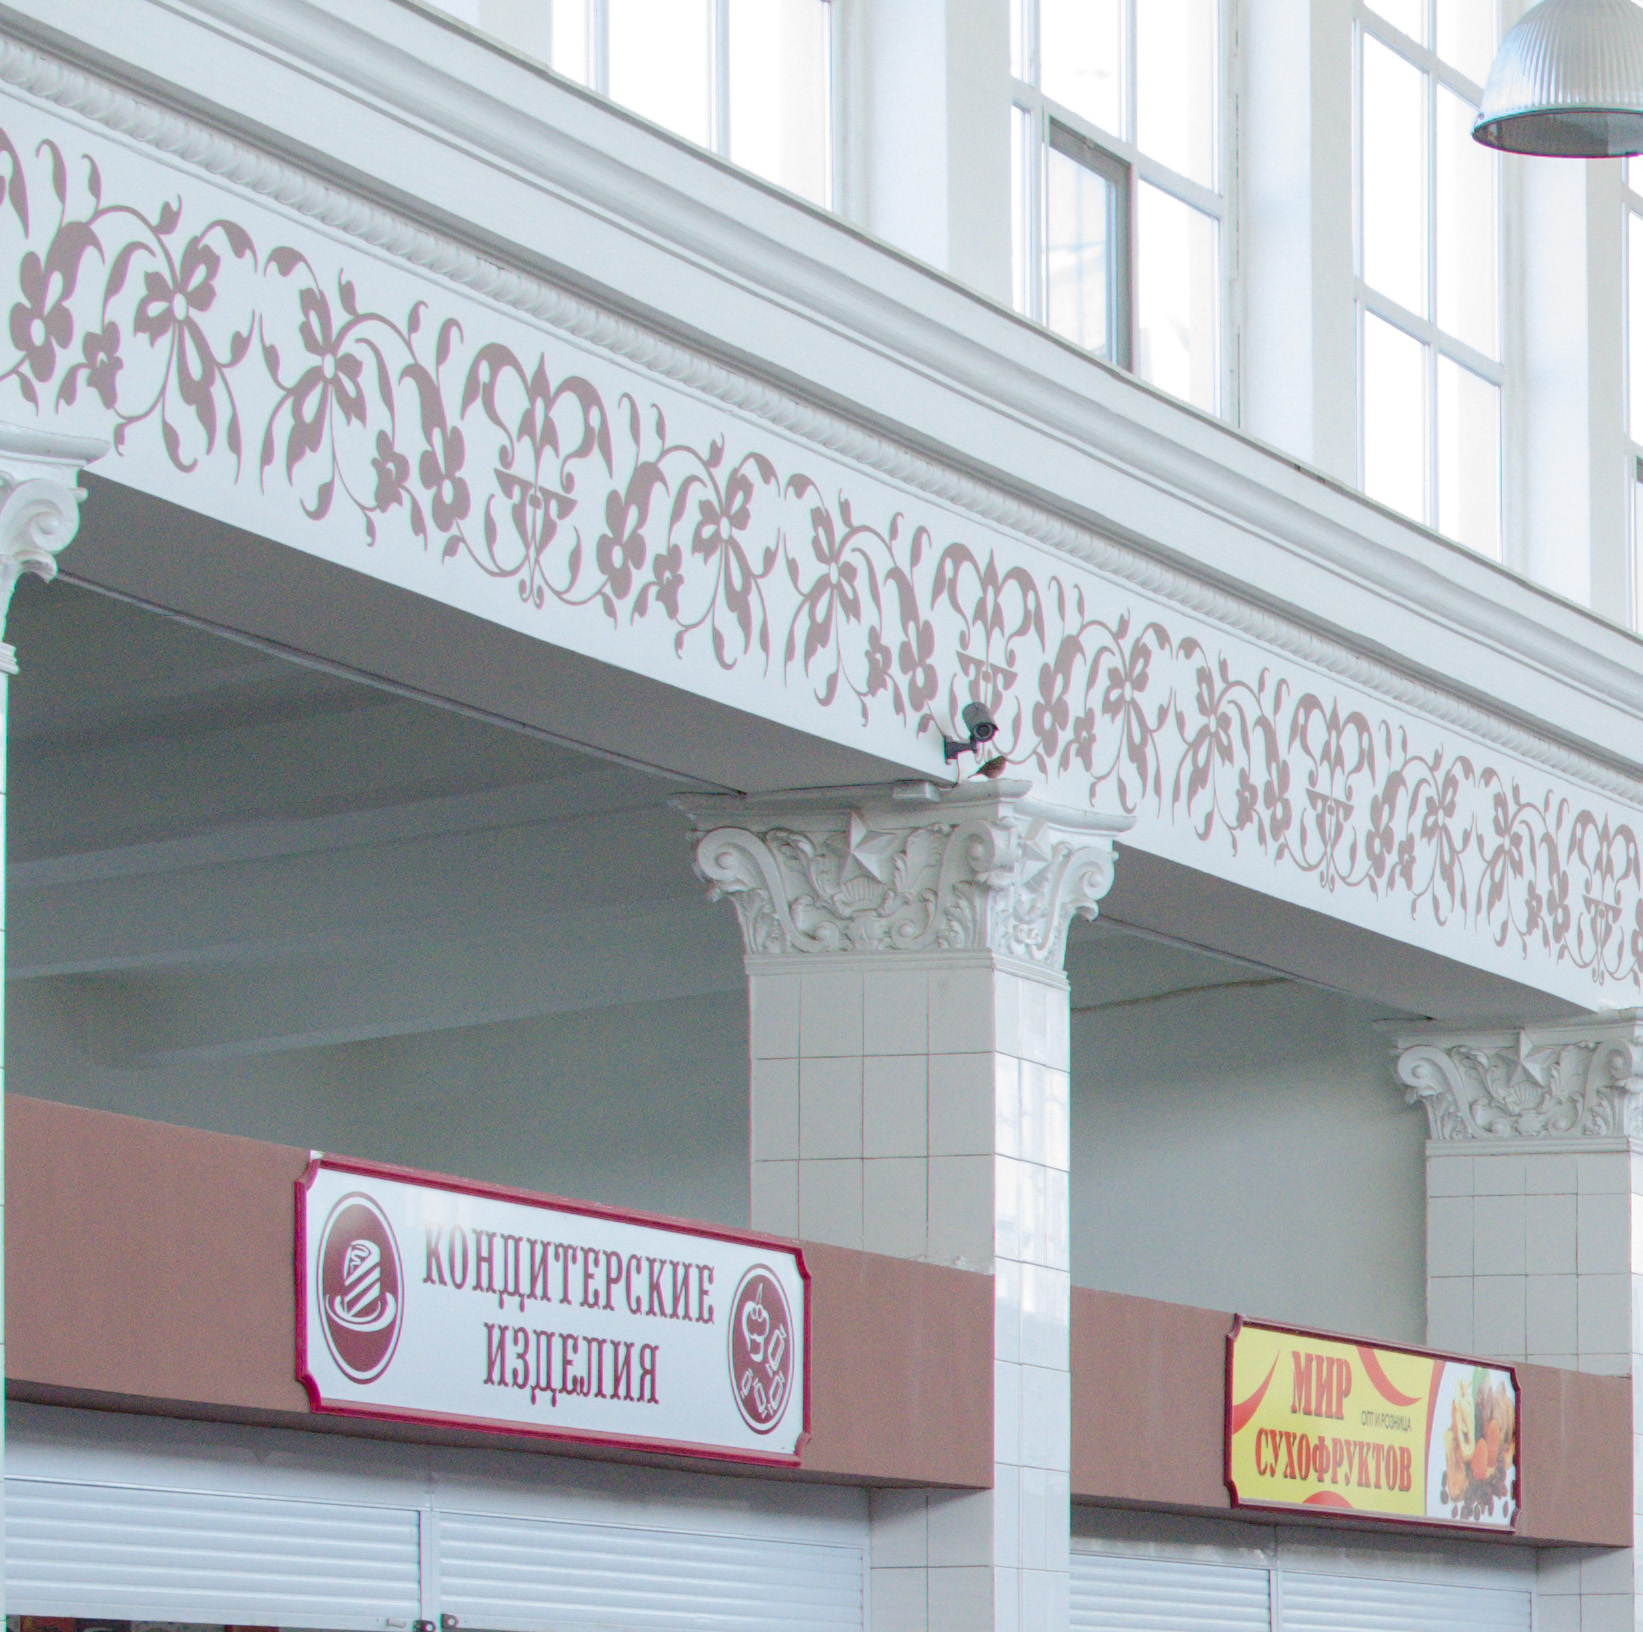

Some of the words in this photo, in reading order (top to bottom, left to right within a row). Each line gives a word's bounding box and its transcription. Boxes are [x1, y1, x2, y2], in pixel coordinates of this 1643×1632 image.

[423, 1221, 715, 1324] КОНДИТЕРСКИЕ
[483, 1322, 660, 1407] ИЗДЕЛИЯ
[1290, 1350, 1352, 1420] МИР
[1255, 1427, 1412, 1493] СУХОФРУКТОВ
